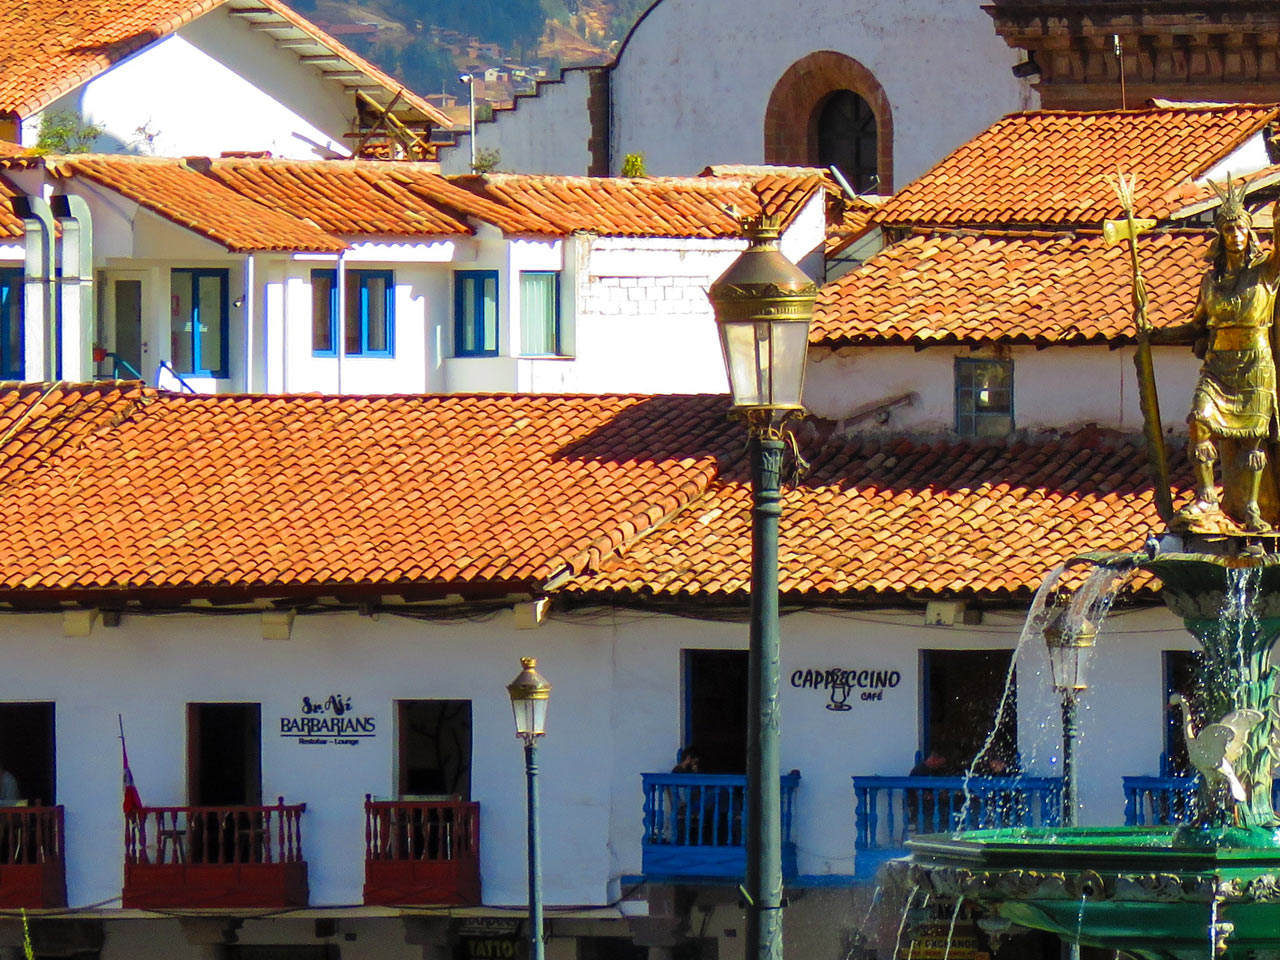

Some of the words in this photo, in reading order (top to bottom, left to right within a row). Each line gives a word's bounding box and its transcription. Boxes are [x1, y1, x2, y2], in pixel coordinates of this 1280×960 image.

[861, 689, 883, 701] CAFÉ
[302, 696, 325, 715] Sr.
[280, 717, 376, 736] BARBARIANS
[335, 738, 360, 746] Lounge
